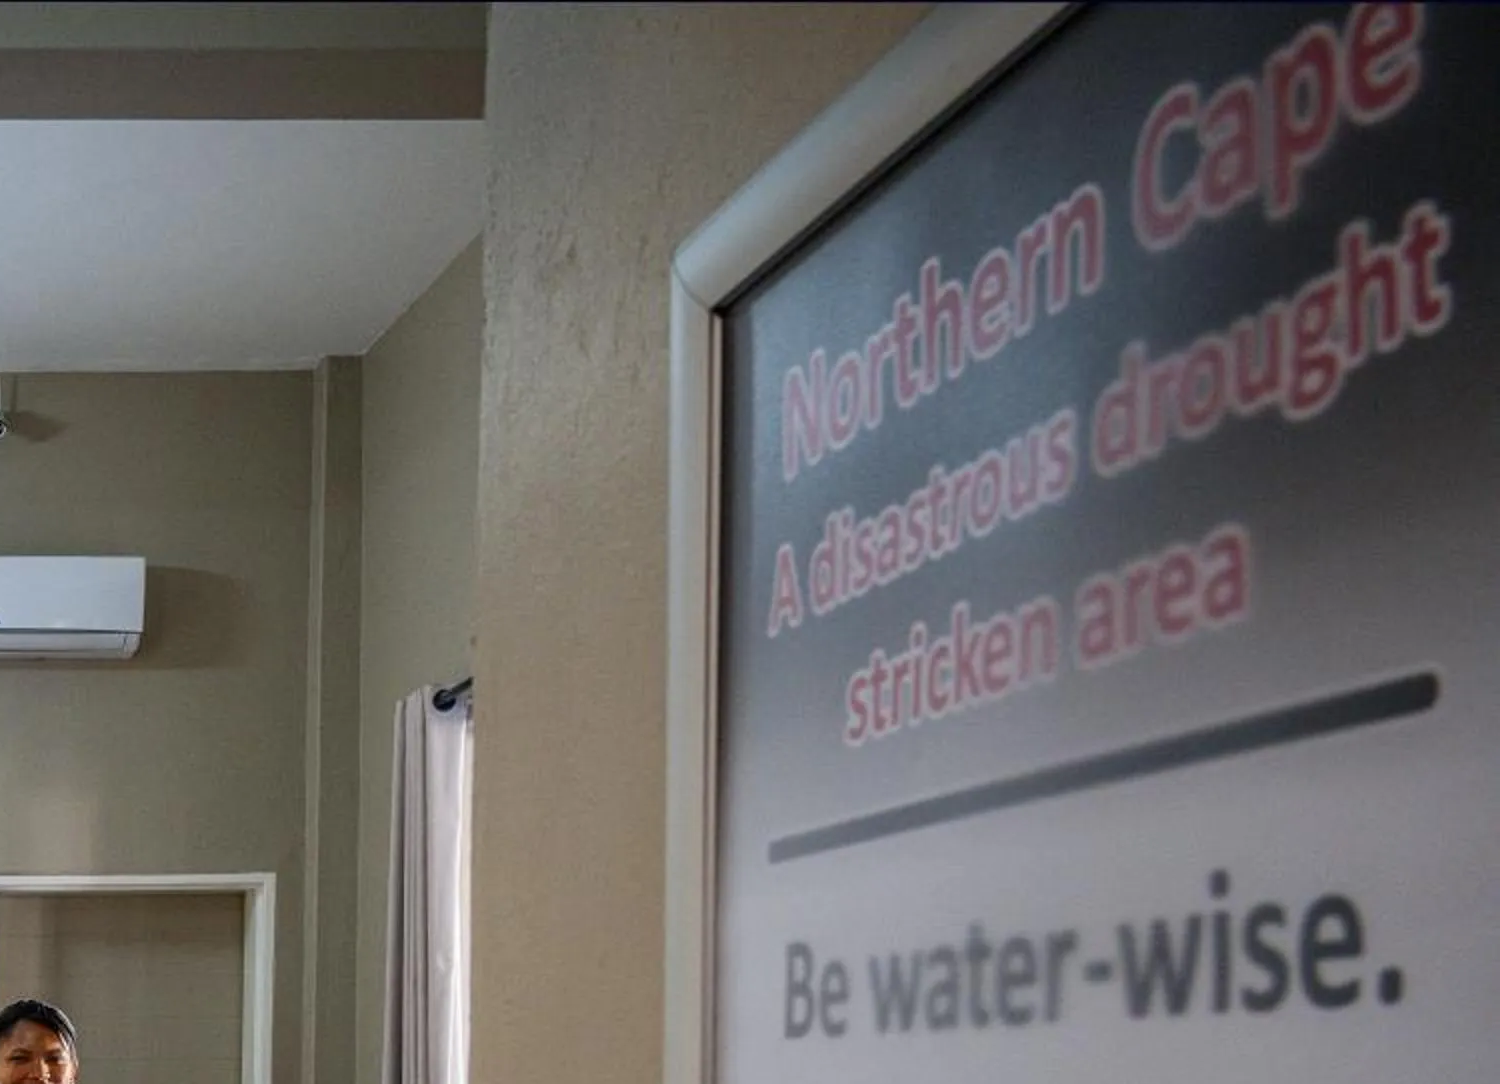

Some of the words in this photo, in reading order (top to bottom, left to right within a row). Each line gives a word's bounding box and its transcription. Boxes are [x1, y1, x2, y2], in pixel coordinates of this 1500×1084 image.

[782, 183, 1104, 482] Northern
[1131, 0, 1424, 250] Cape
[767, 545, 801, 637] A
[808, 408, 1078, 615] disastrous
[1092, 202, 1450, 475] drought
[844, 595, 1060, 747] stricken
[1077, 523, 1251, 670] area
[783, 942, 851, 1040] Be
[869, 867, 1406, 1035] water-wise.
